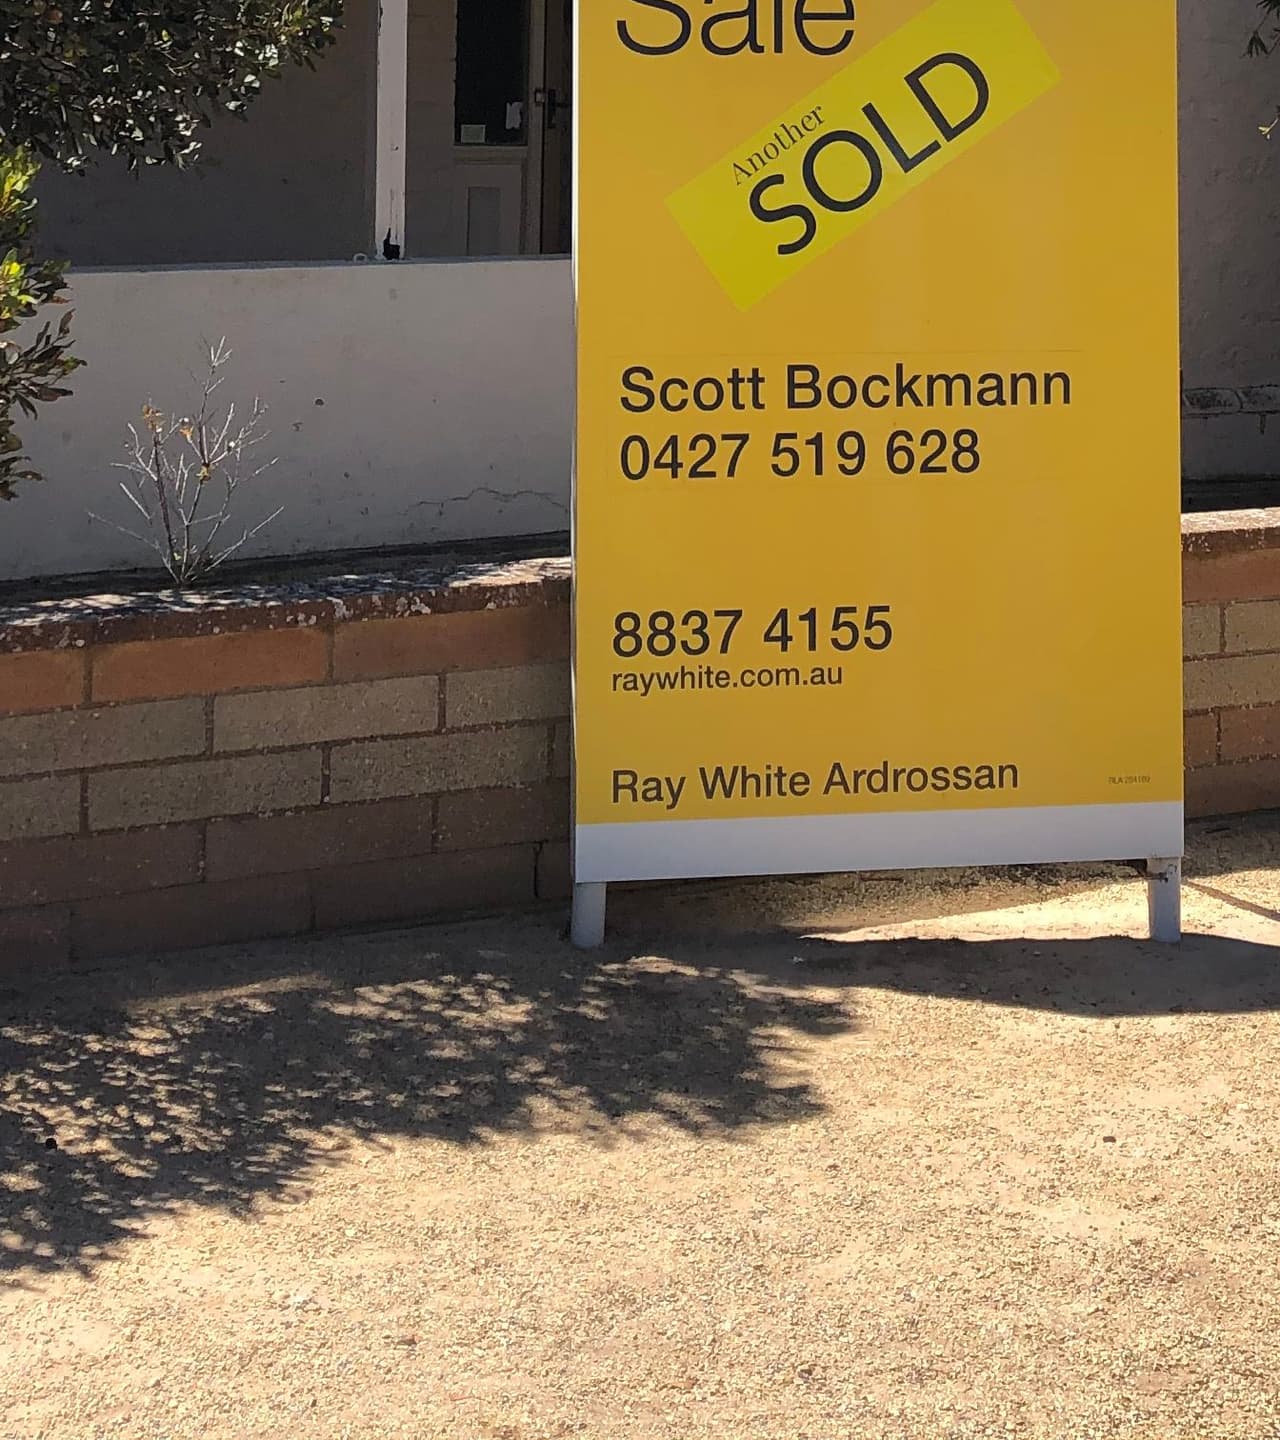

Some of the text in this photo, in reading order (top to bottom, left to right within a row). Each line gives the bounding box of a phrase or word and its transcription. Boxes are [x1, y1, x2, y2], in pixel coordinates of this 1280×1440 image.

[732, 105, 824, 186] Another
[748, 52, 990, 256] SOLD
[620, 363, 1070, 413] Scott Bockmann
[620, 428, 980, 481] 0427 519 628
[613, 605, 892, 658] 8837 4155
[612, 665, 843, 697] raywhite.com.au
[612, 760, 1018, 810] Ray White Ardrossan
